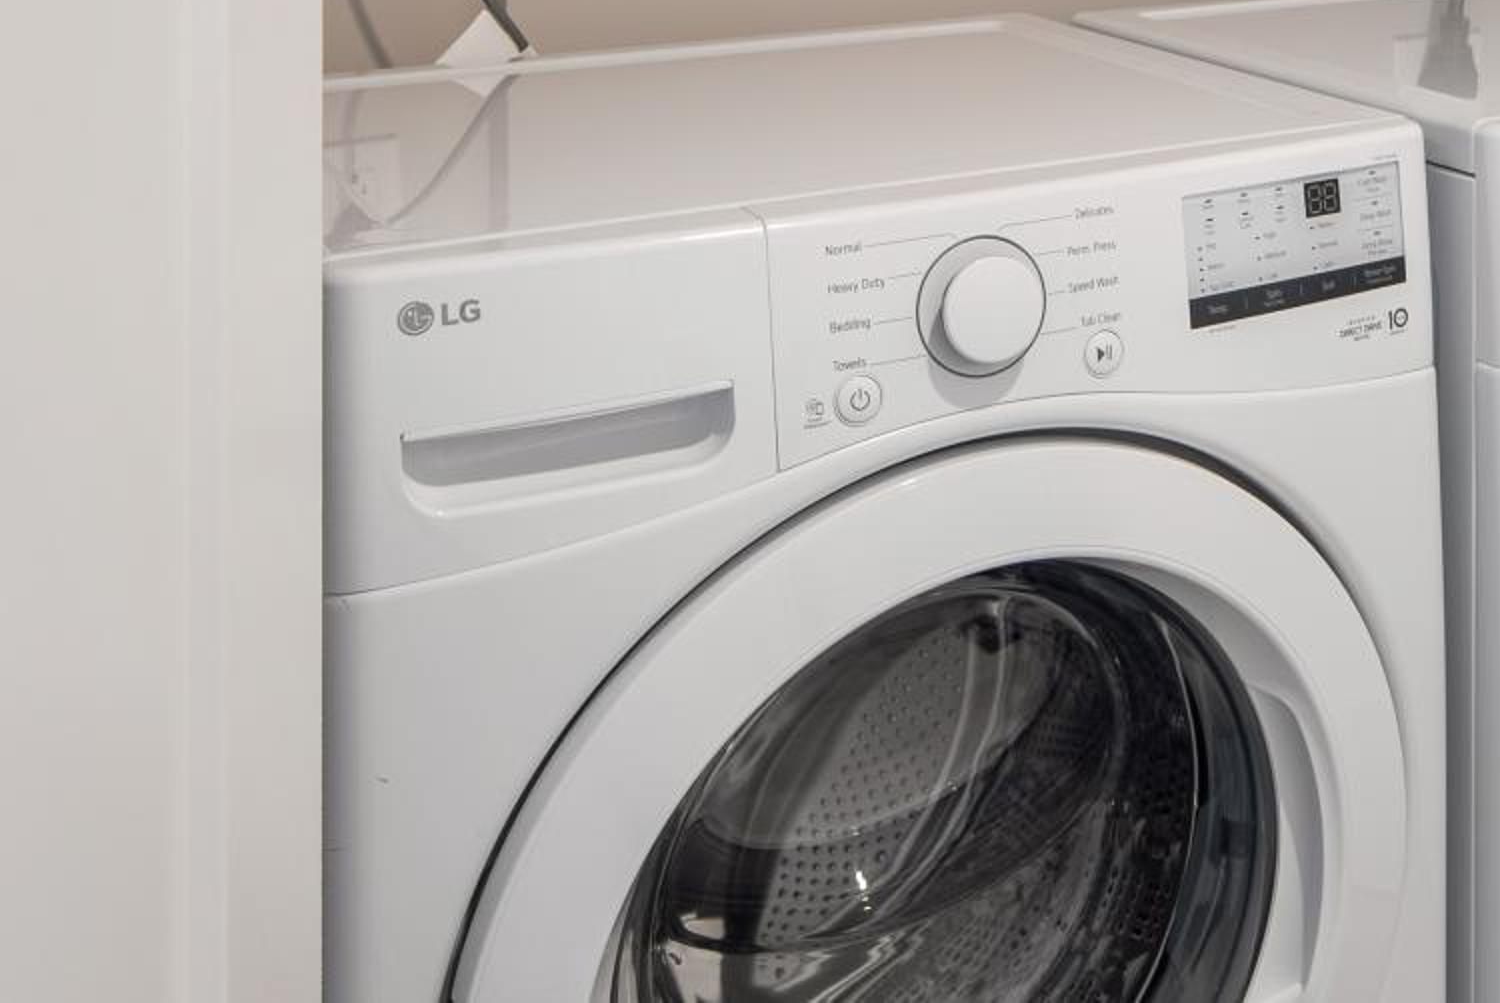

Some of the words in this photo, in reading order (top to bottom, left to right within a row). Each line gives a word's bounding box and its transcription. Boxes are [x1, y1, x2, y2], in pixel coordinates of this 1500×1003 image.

[825, 241, 862, 256] Normal
[827, 282, 858, 294] Heavy
[861, 278, 885, 290] Duty
[441, 299, 480, 325] LG
[829, 317, 871, 334] Bedding
[832, 357, 866, 372] Towels
